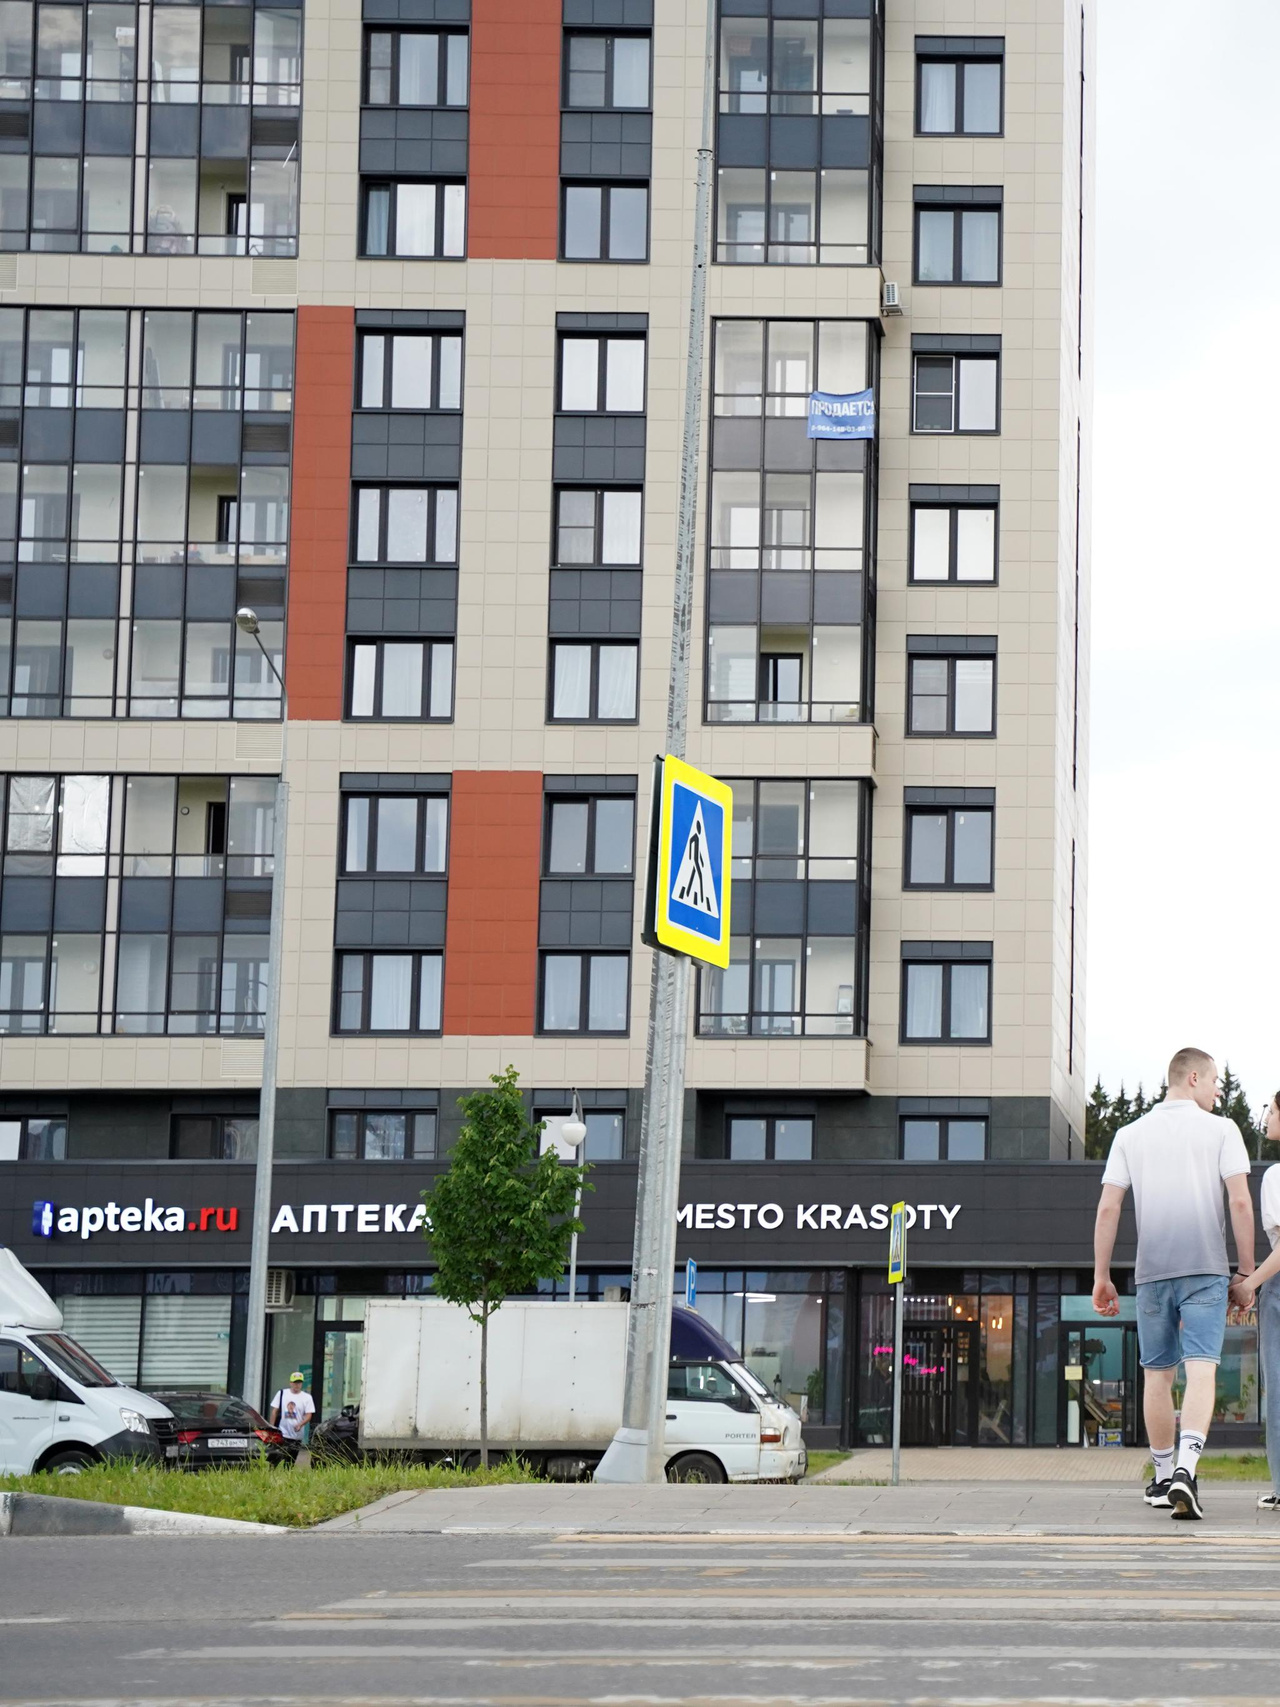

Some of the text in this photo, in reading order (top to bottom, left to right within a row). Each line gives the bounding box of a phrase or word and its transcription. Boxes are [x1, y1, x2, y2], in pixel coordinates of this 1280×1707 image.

[57, 1198, 238, 1240] apteka.ru
[271, 1203, 434, 1233] АПТЕКА
[676, 1203, 784, 1230] MESTO
